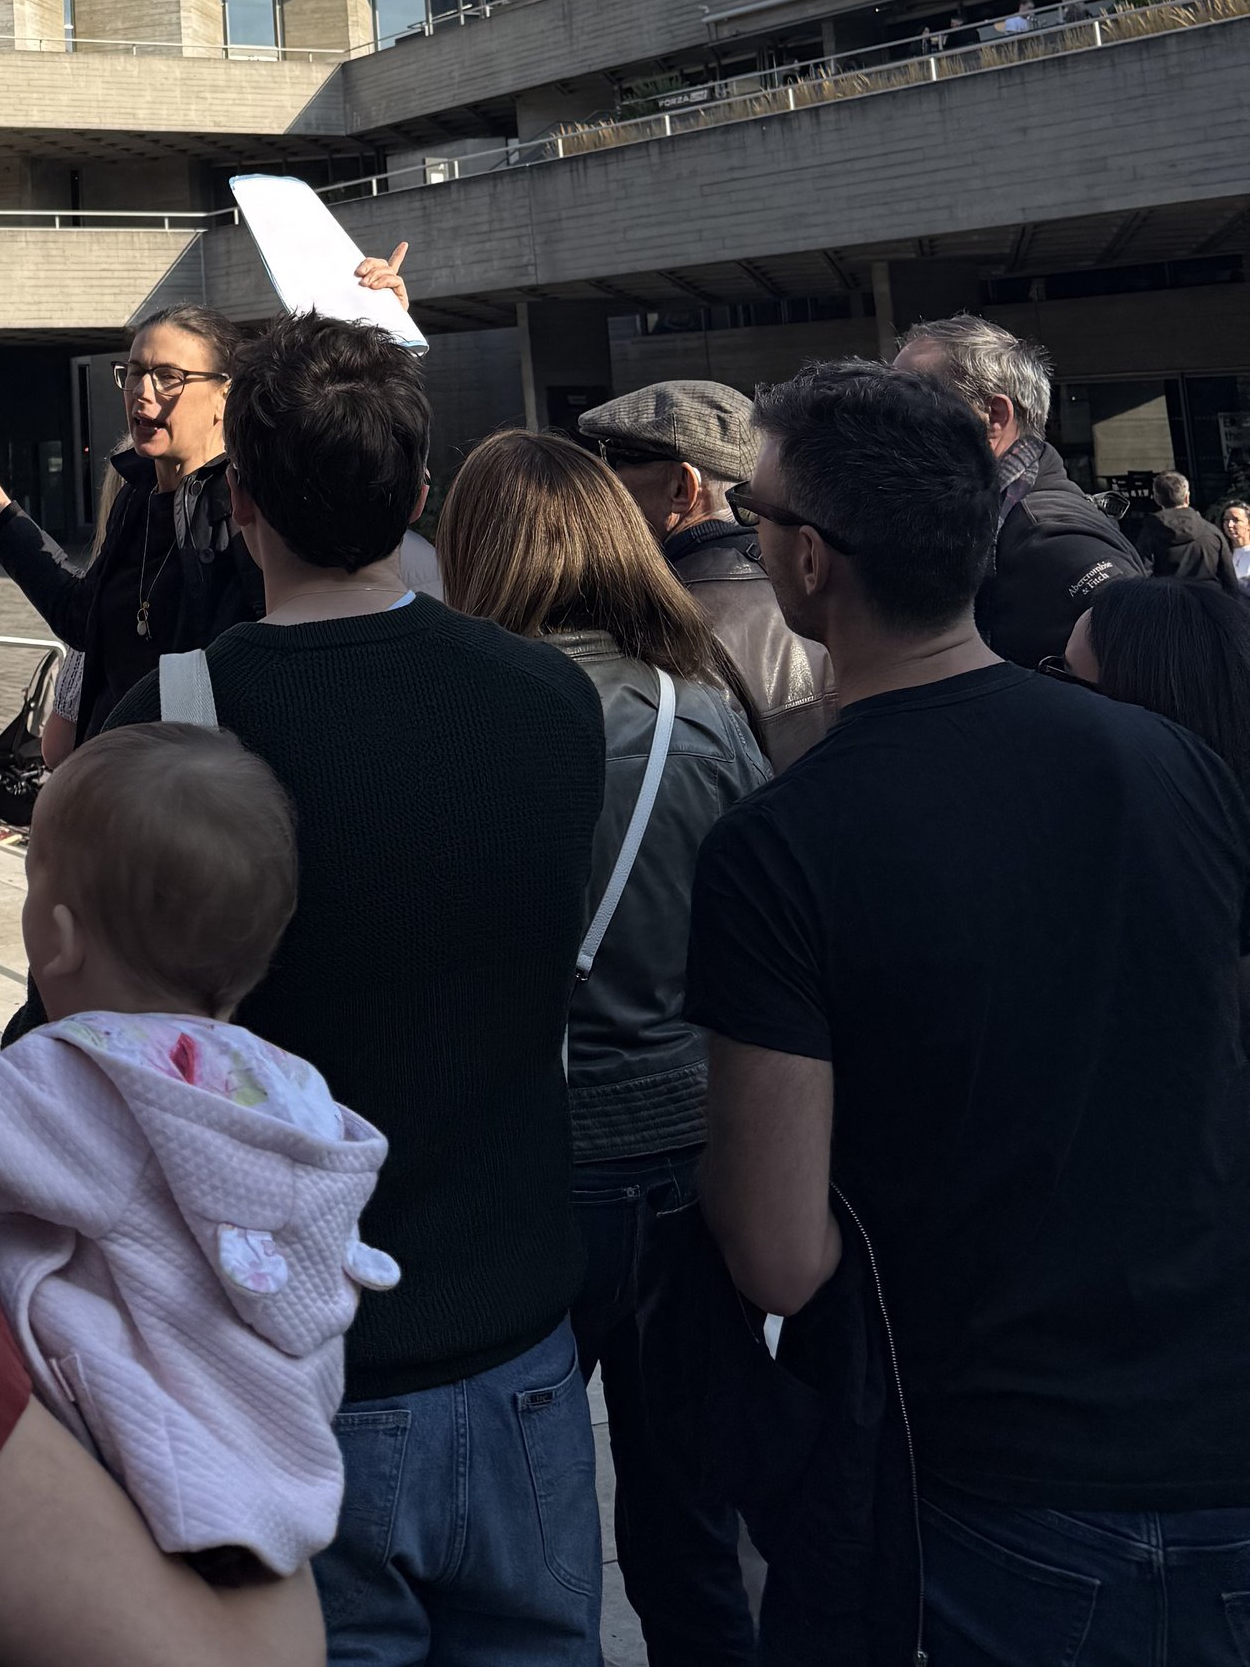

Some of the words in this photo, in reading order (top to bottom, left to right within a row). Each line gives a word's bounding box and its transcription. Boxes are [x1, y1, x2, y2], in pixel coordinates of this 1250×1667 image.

[658, 95, 690, 108] FORZA
[1068, 561, 1113, 597] Abercrombie
[1087, 572, 1110, 589] Fitch
